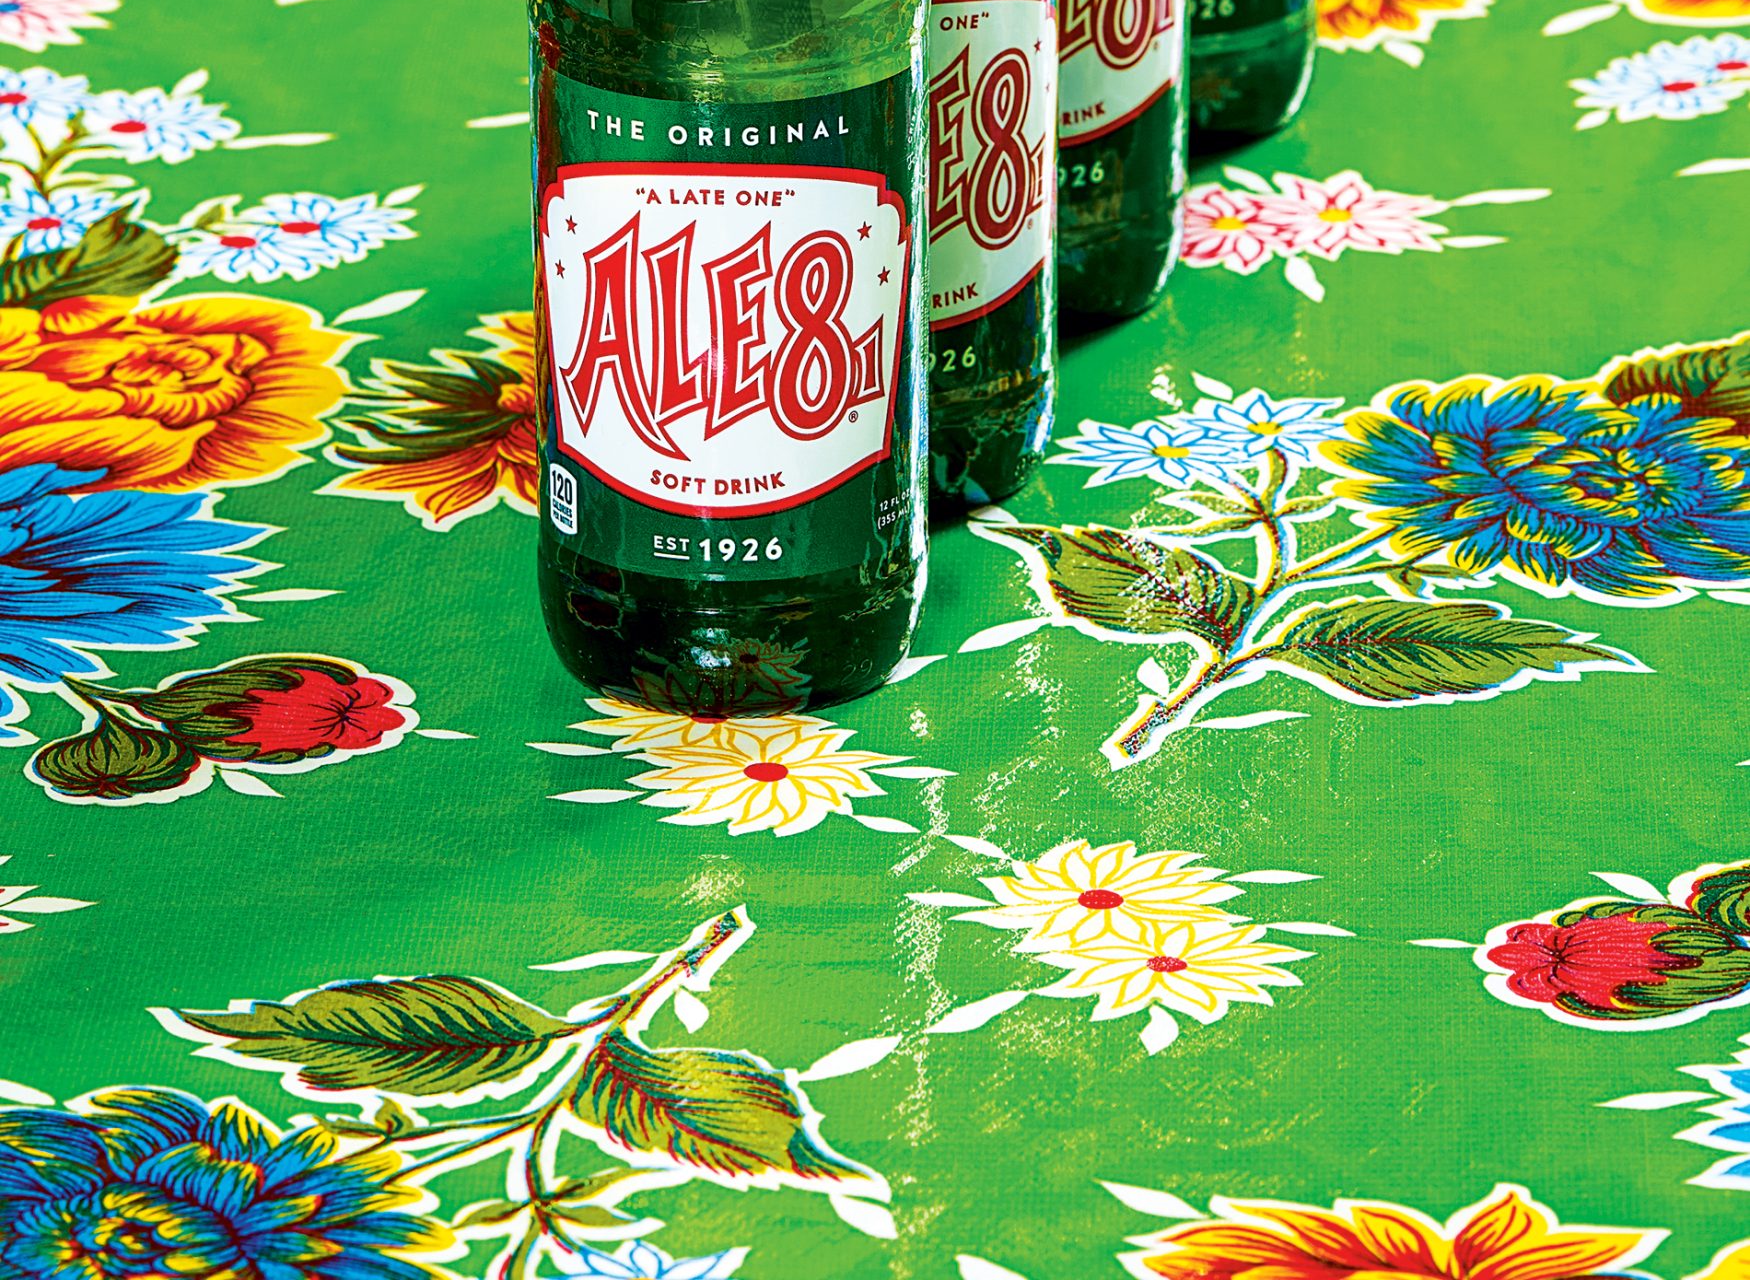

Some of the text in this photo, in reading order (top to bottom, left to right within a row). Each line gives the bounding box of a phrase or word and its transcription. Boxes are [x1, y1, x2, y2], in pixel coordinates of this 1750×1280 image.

[1062, 101, 1105, 126] RINK
[587, 109, 849, 147] THE ORIGINAL
[636, 188, 796, 207] "A LATE ONE"
[932, 282, 979, 309] RINK
[552, 470, 572, 505] 120
[650, 469, 786, 496] SOFT DRINK
[880, 500, 888, 512] 12
[891, 496, 900, 507] FL
[878, 511, 896, 530] (355
[653, 535, 783, 562] EST 1926
